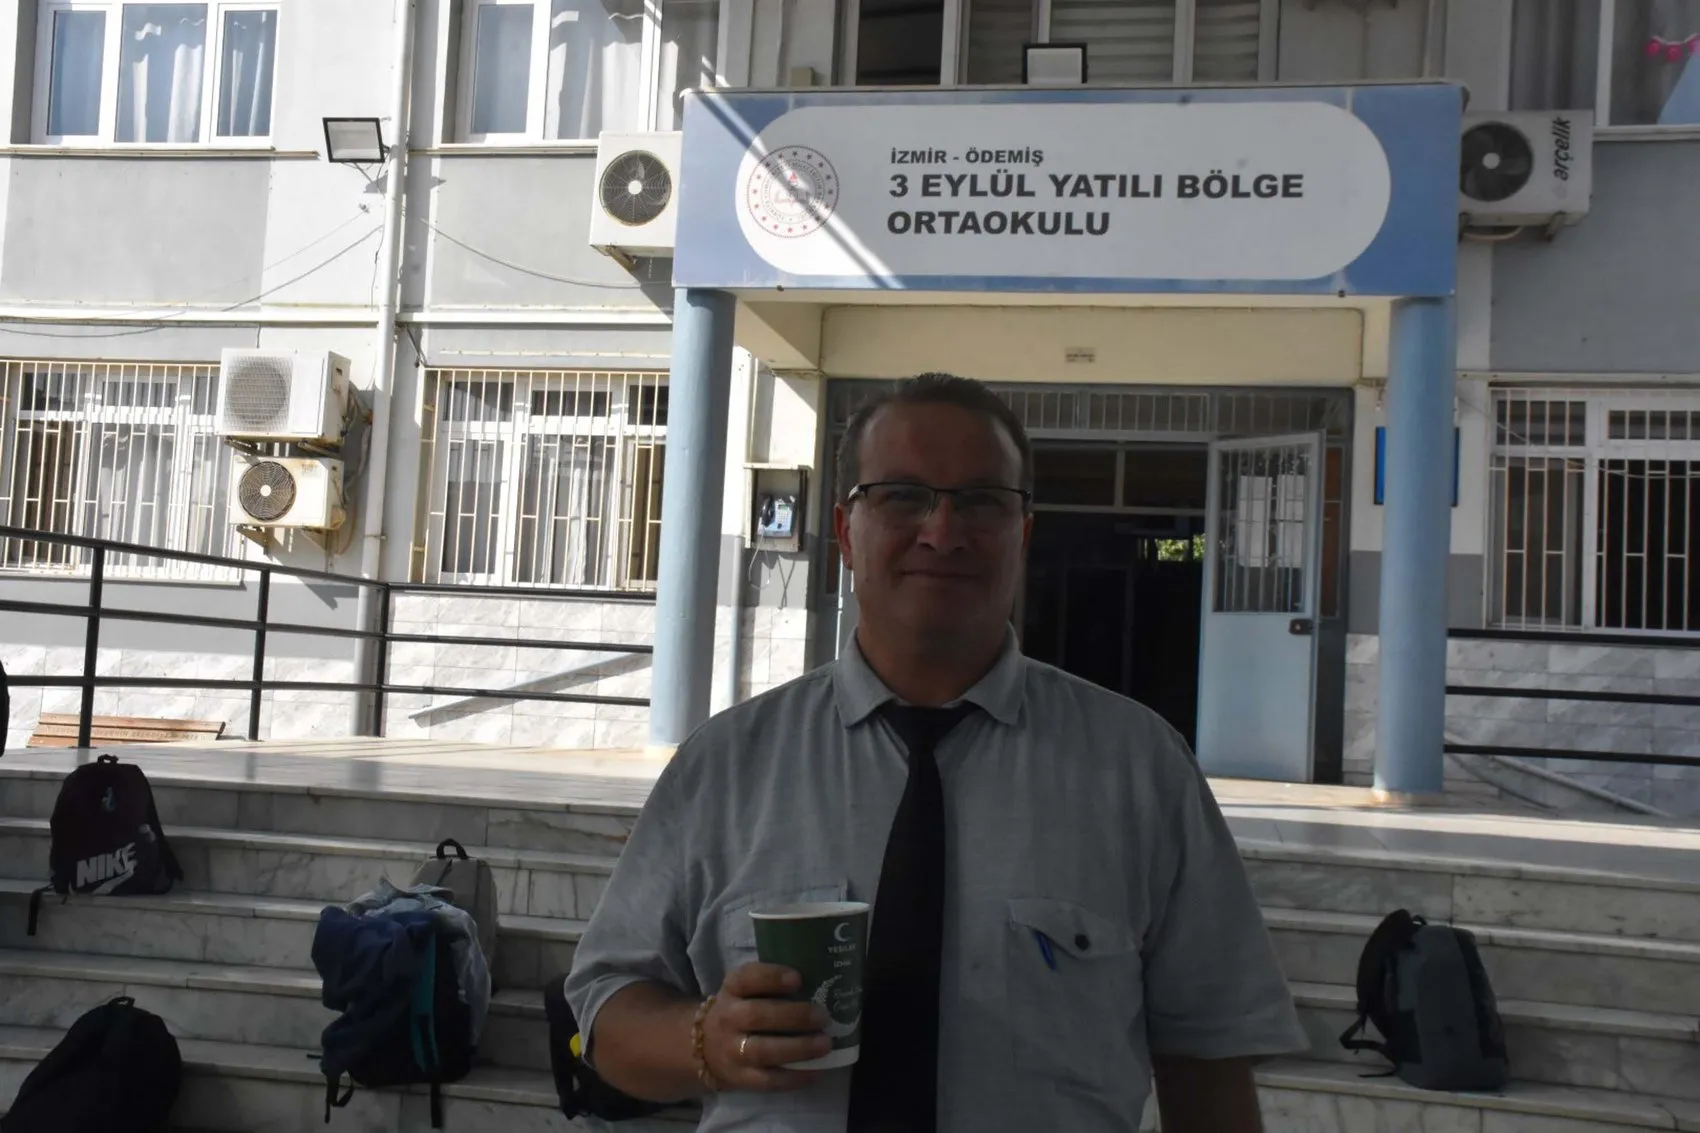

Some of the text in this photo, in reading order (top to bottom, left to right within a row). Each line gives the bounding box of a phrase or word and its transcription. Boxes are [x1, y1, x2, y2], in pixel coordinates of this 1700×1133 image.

[891, 147, 947, 164] İZMİR
[966, 147, 1044, 167] ÖDEMİŞ
[1551, 116, 1574, 181] arçelik
[890, 168, 1304, 199] 3 EYLÜL YATILI BÖLGE
[887, 210, 1110, 236] ORTAOKULU
[76, 842, 138, 888] NIKE
